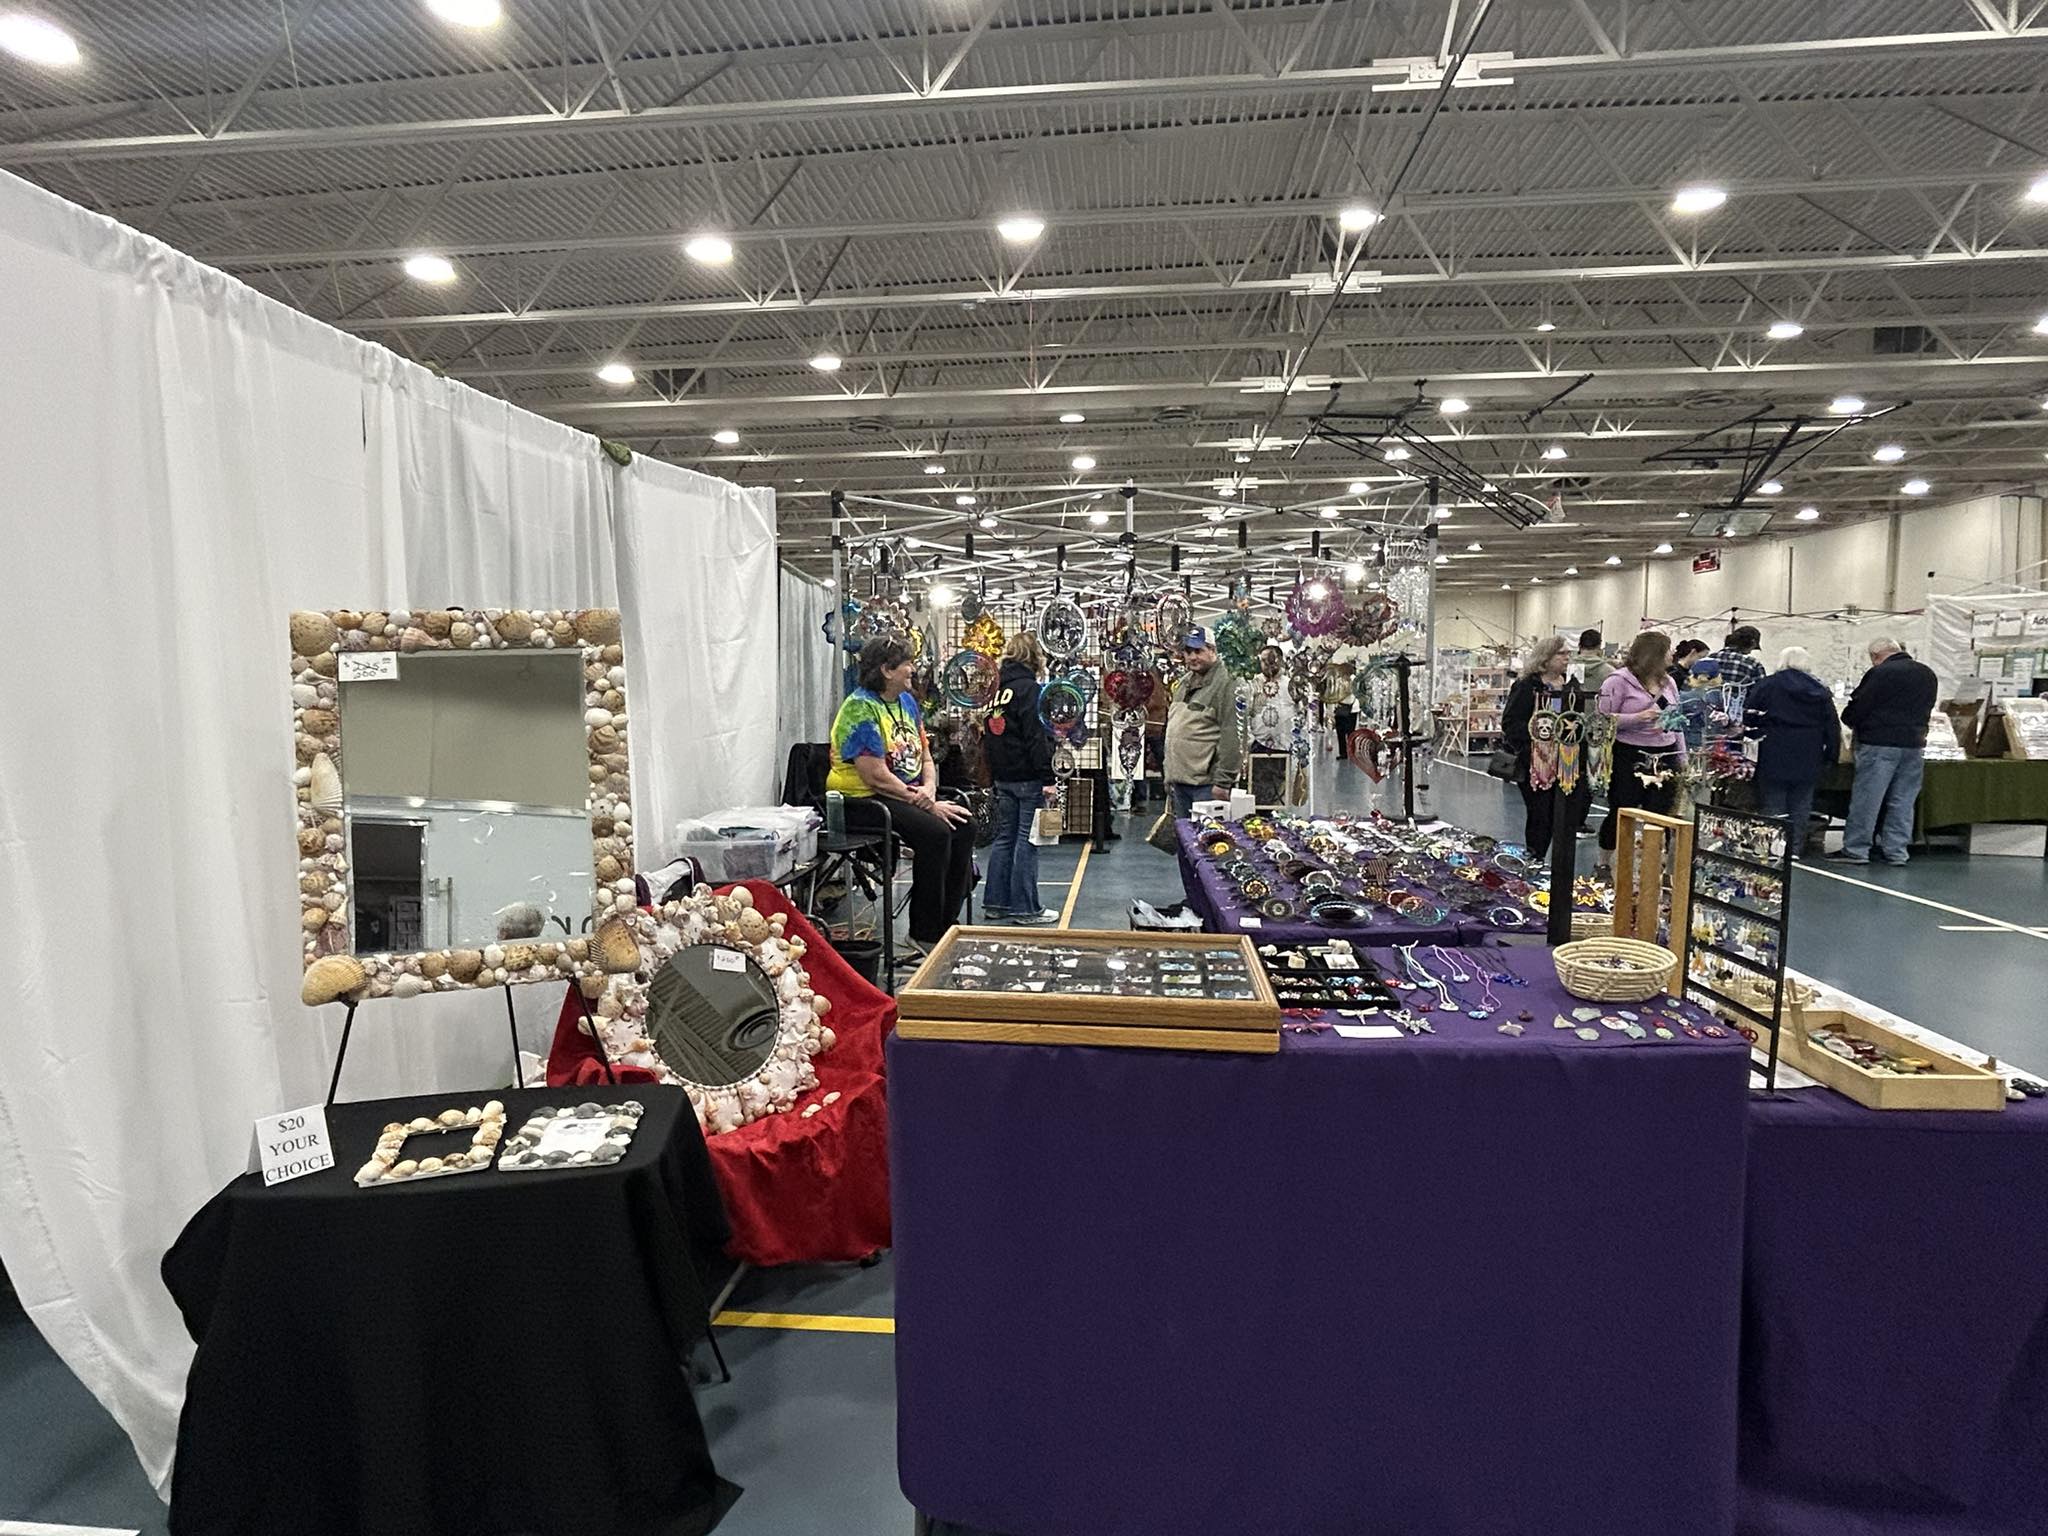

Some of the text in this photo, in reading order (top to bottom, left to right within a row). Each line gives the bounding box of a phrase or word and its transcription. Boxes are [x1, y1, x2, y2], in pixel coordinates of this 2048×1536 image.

[277, 1115, 305, 1133] $20
[269, 1134, 320, 1156] YOUR
[265, 1153, 331, 1182] CHOICE
